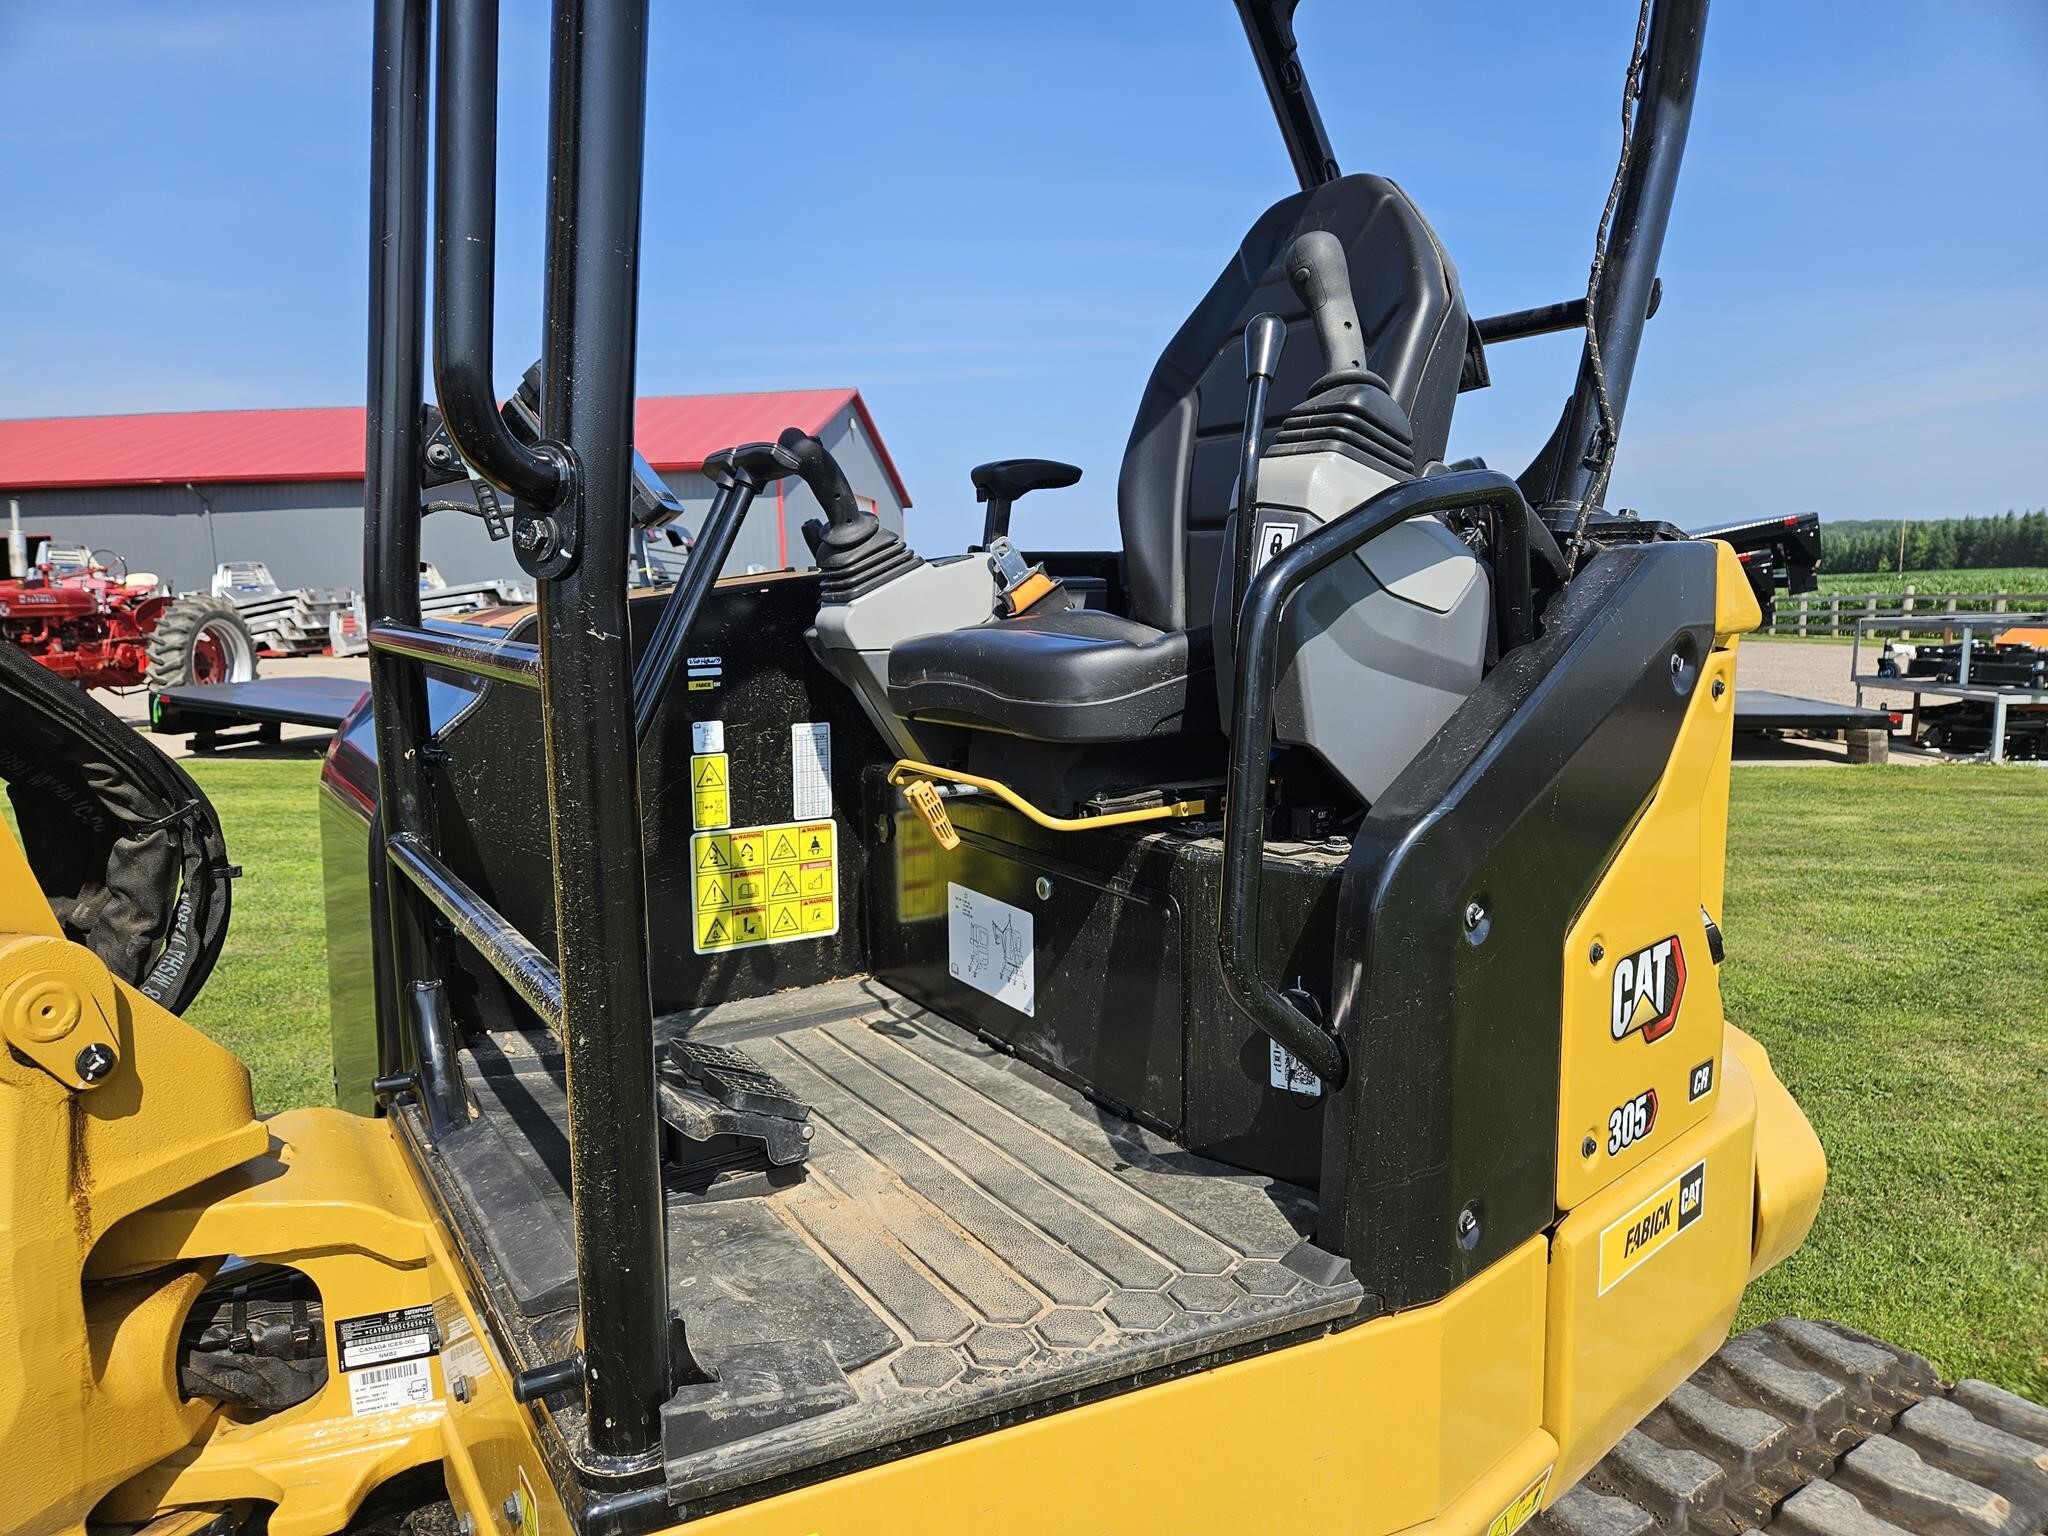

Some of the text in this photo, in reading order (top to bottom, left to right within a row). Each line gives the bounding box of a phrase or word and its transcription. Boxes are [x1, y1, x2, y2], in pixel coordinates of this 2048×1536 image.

[738, 832, 763, 840] WARNING
[807, 825, 831, 833] WARNING
[740, 869, 764, 878] WARNING
[808, 897, 833, 905] WARNING
[741, 905, 766, 915] WARNING
[150, 949, 186, 989] MSHA
[1612, 939, 1672, 1039] CAT
[1693, 1068, 1710, 1095] CR
[1608, 1093, 1648, 1155] 305
[1624, 1178, 1702, 1259] FABICK CAT
[358, 1338, 416, 1353] CANADA ICES-002
